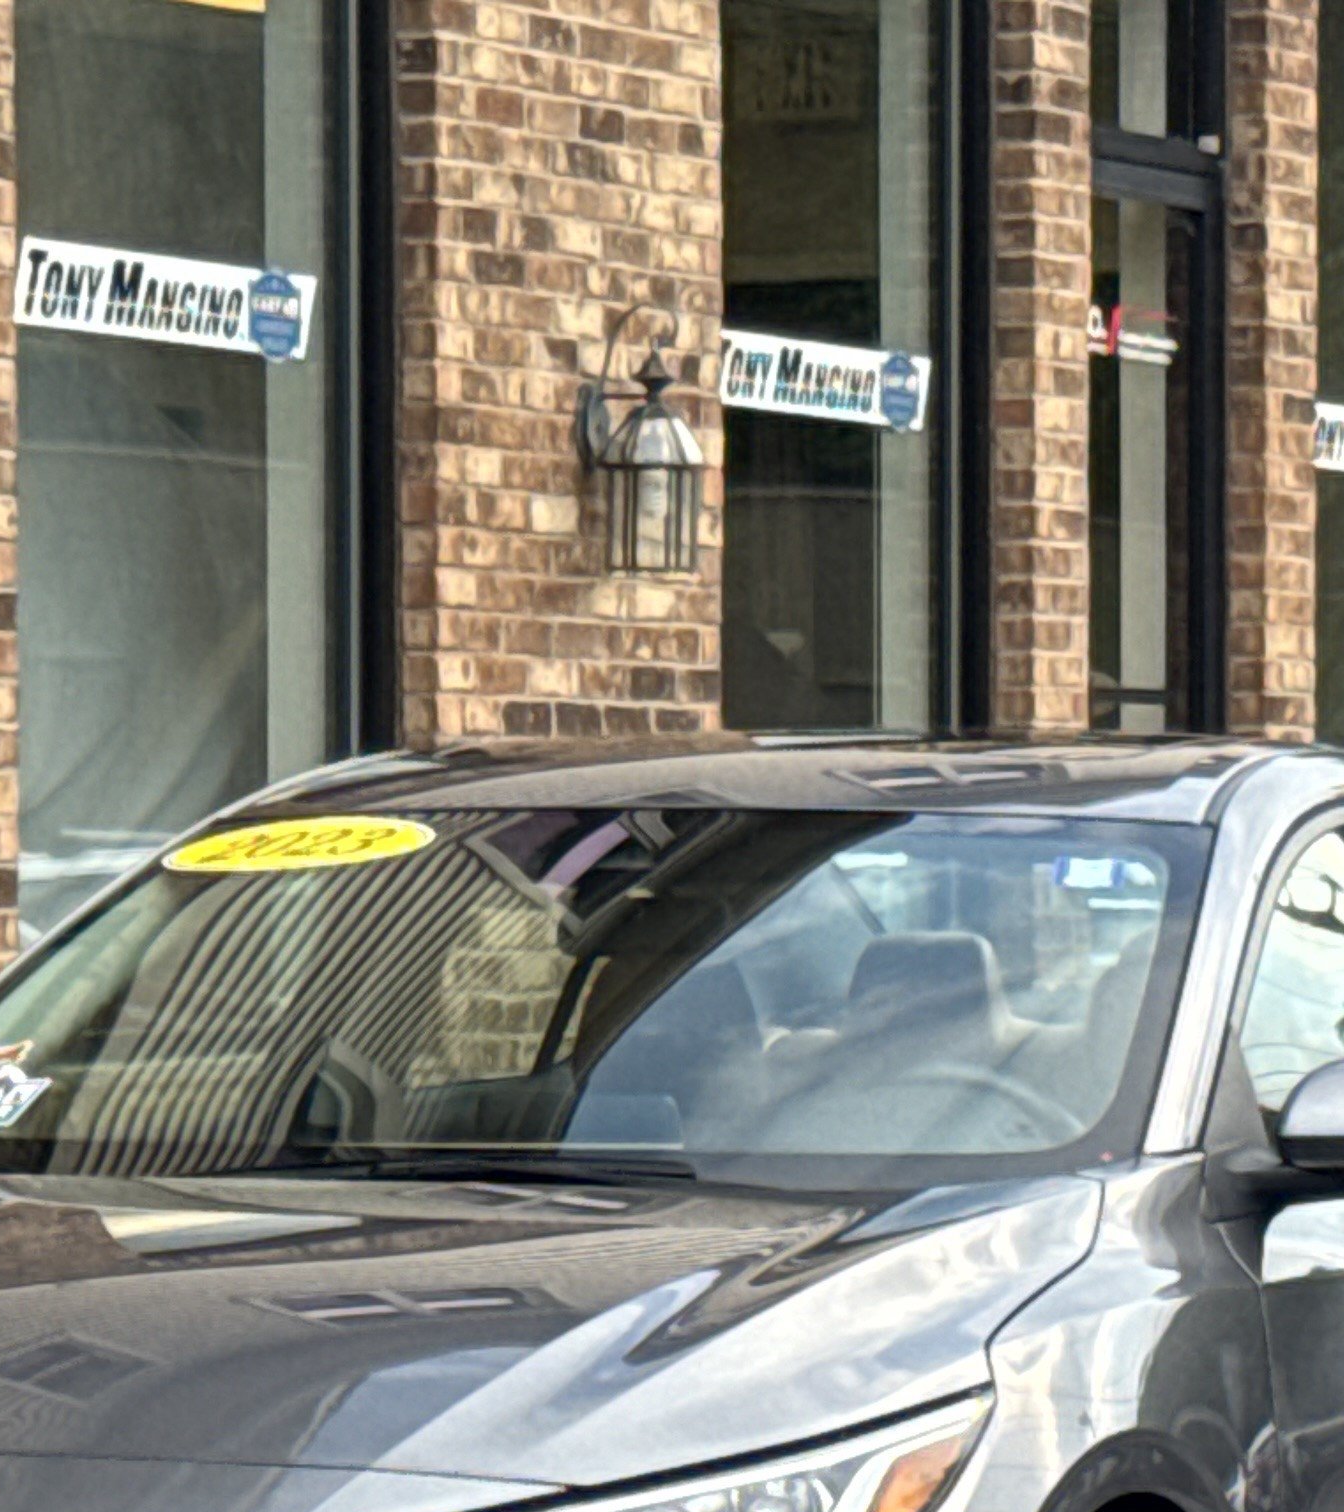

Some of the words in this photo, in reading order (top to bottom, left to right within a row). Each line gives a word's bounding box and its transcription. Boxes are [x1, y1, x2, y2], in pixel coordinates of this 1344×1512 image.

[24, 248, 105, 322] TONY
[104, 259, 243, 340] MANGINO
[196, 827, 398, 864] 2023
